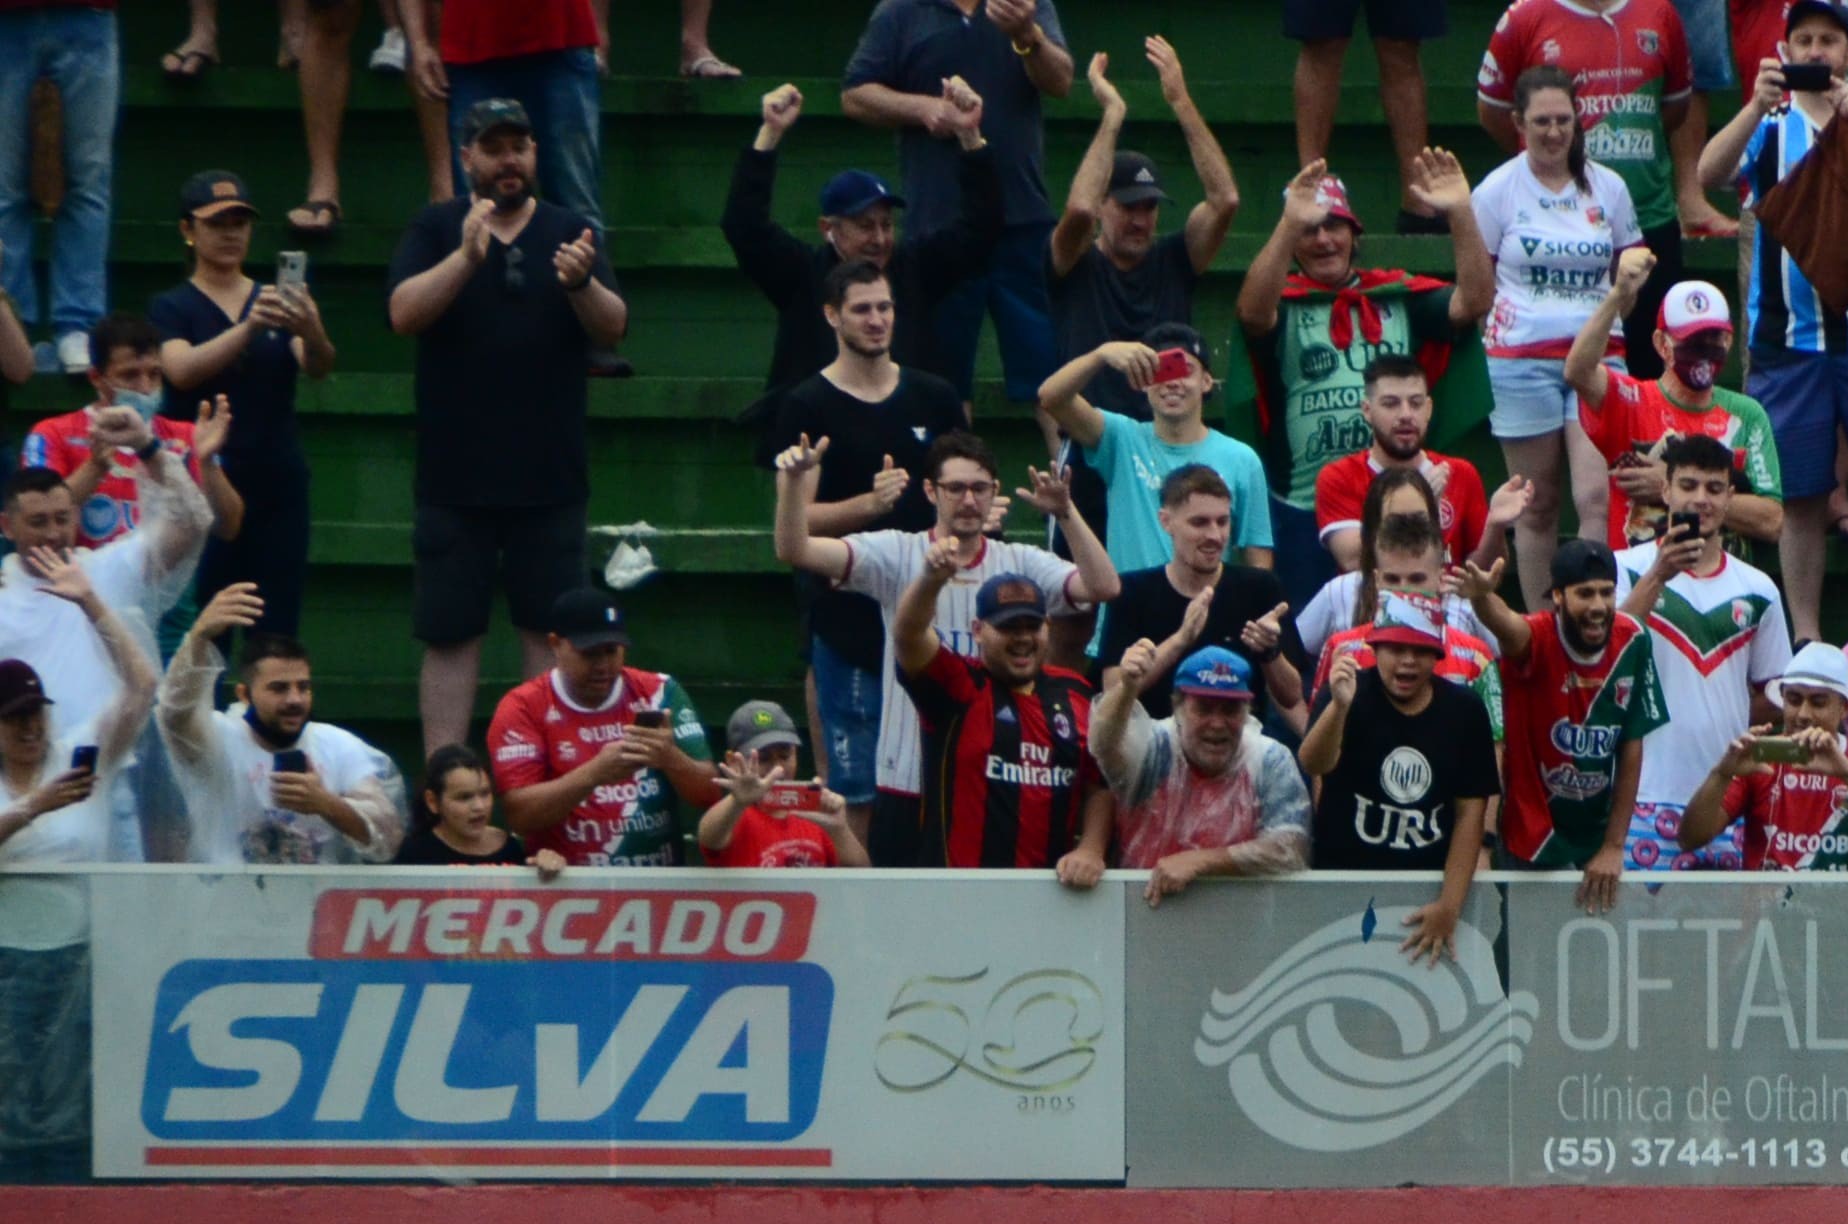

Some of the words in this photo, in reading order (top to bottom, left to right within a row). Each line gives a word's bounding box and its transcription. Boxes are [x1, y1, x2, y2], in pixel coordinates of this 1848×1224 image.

[1020, 741, 1050, 764] Fly
[1800, 774, 1828, 791] URI
[343, 899, 786, 956] MERCADO
[162, 982, 791, 1124] SILVA
[1016, 1094, 1077, 1111] anos
[1556, 1074, 1671, 1123] Clínica
[1686, 1074, 1732, 1123] de
[1542, 1138, 1617, 1173] (55)
[1630, 1138, 1827, 1170] 3744-1113
